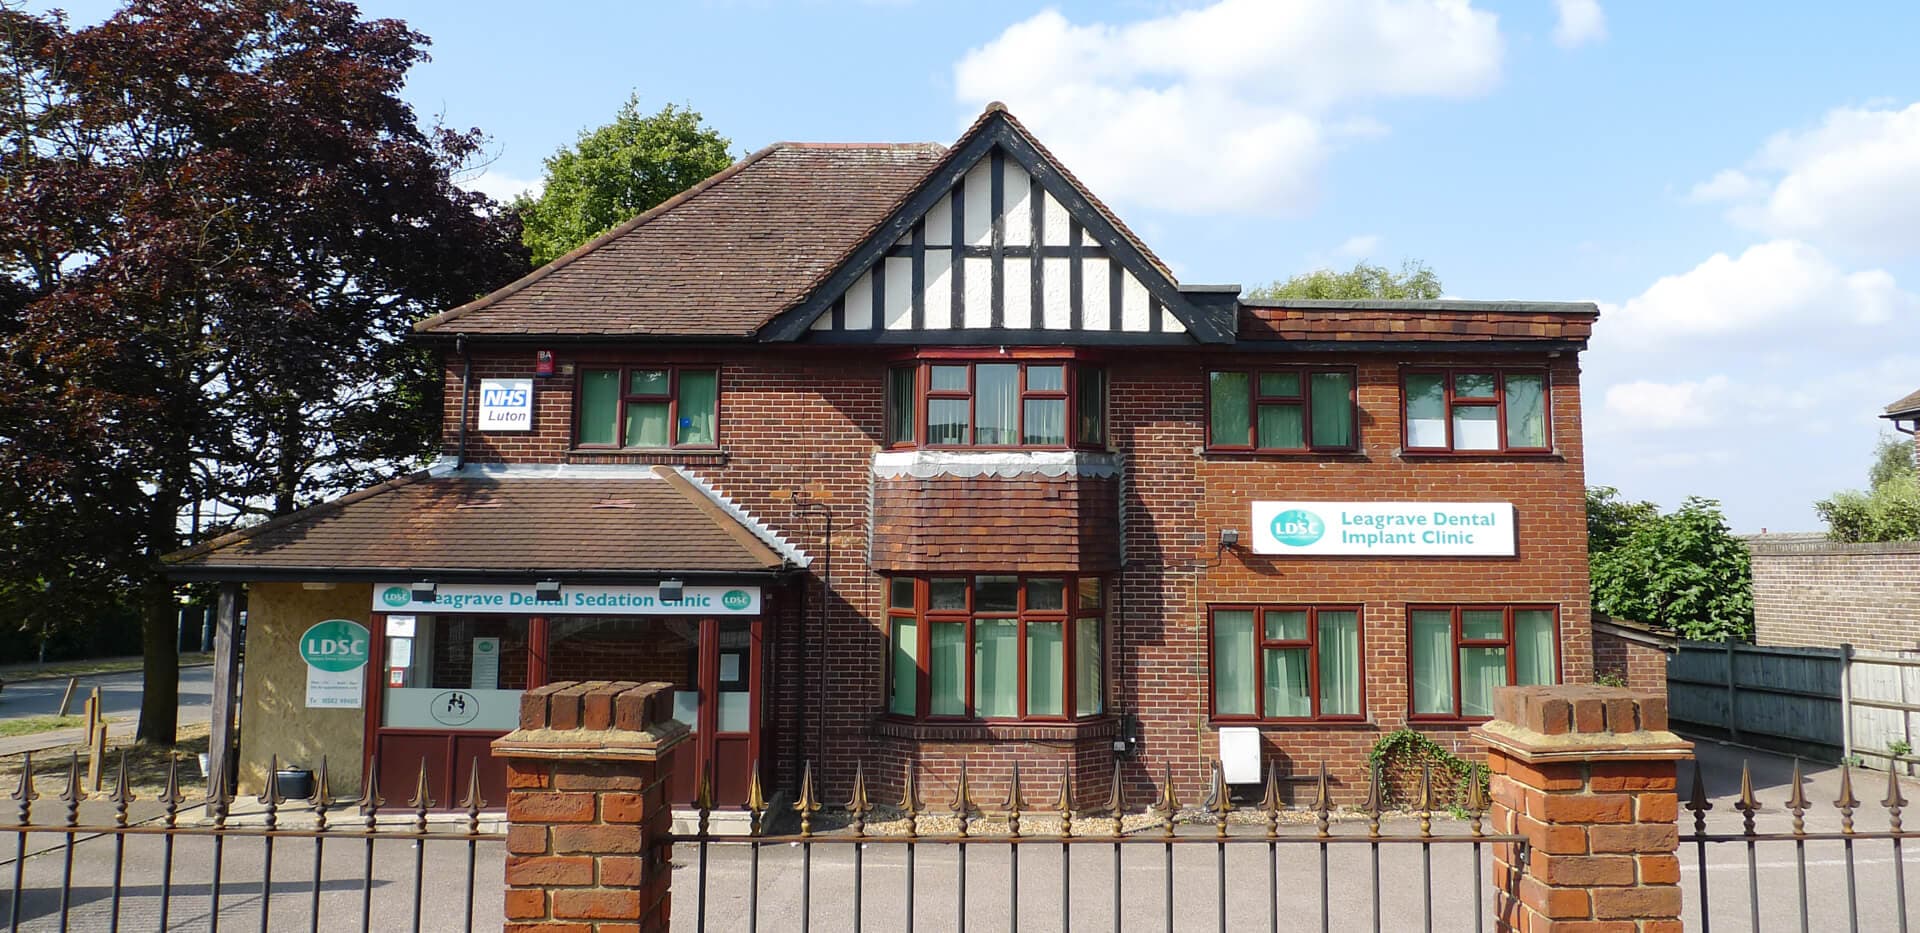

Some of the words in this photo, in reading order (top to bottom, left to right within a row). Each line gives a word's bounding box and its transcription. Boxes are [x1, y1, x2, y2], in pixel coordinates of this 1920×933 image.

[485, 390, 526, 405] NHS
[488, 410, 526, 421] Luton
[1341, 512, 1427, 529] Leagrave
[1434, 512, 1495, 526] Dental
[1275, 522, 1319, 535] LDSC
[1342, 530, 1416, 548] Implant
[1422, 530, 1474, 545] Clinic
[422, 592, 504, 608] eagrave
[575, 593, 654, 607] Sedation
[724, 596, 748, 604] LDSC
[308, 639, 364, 655] LDSC
